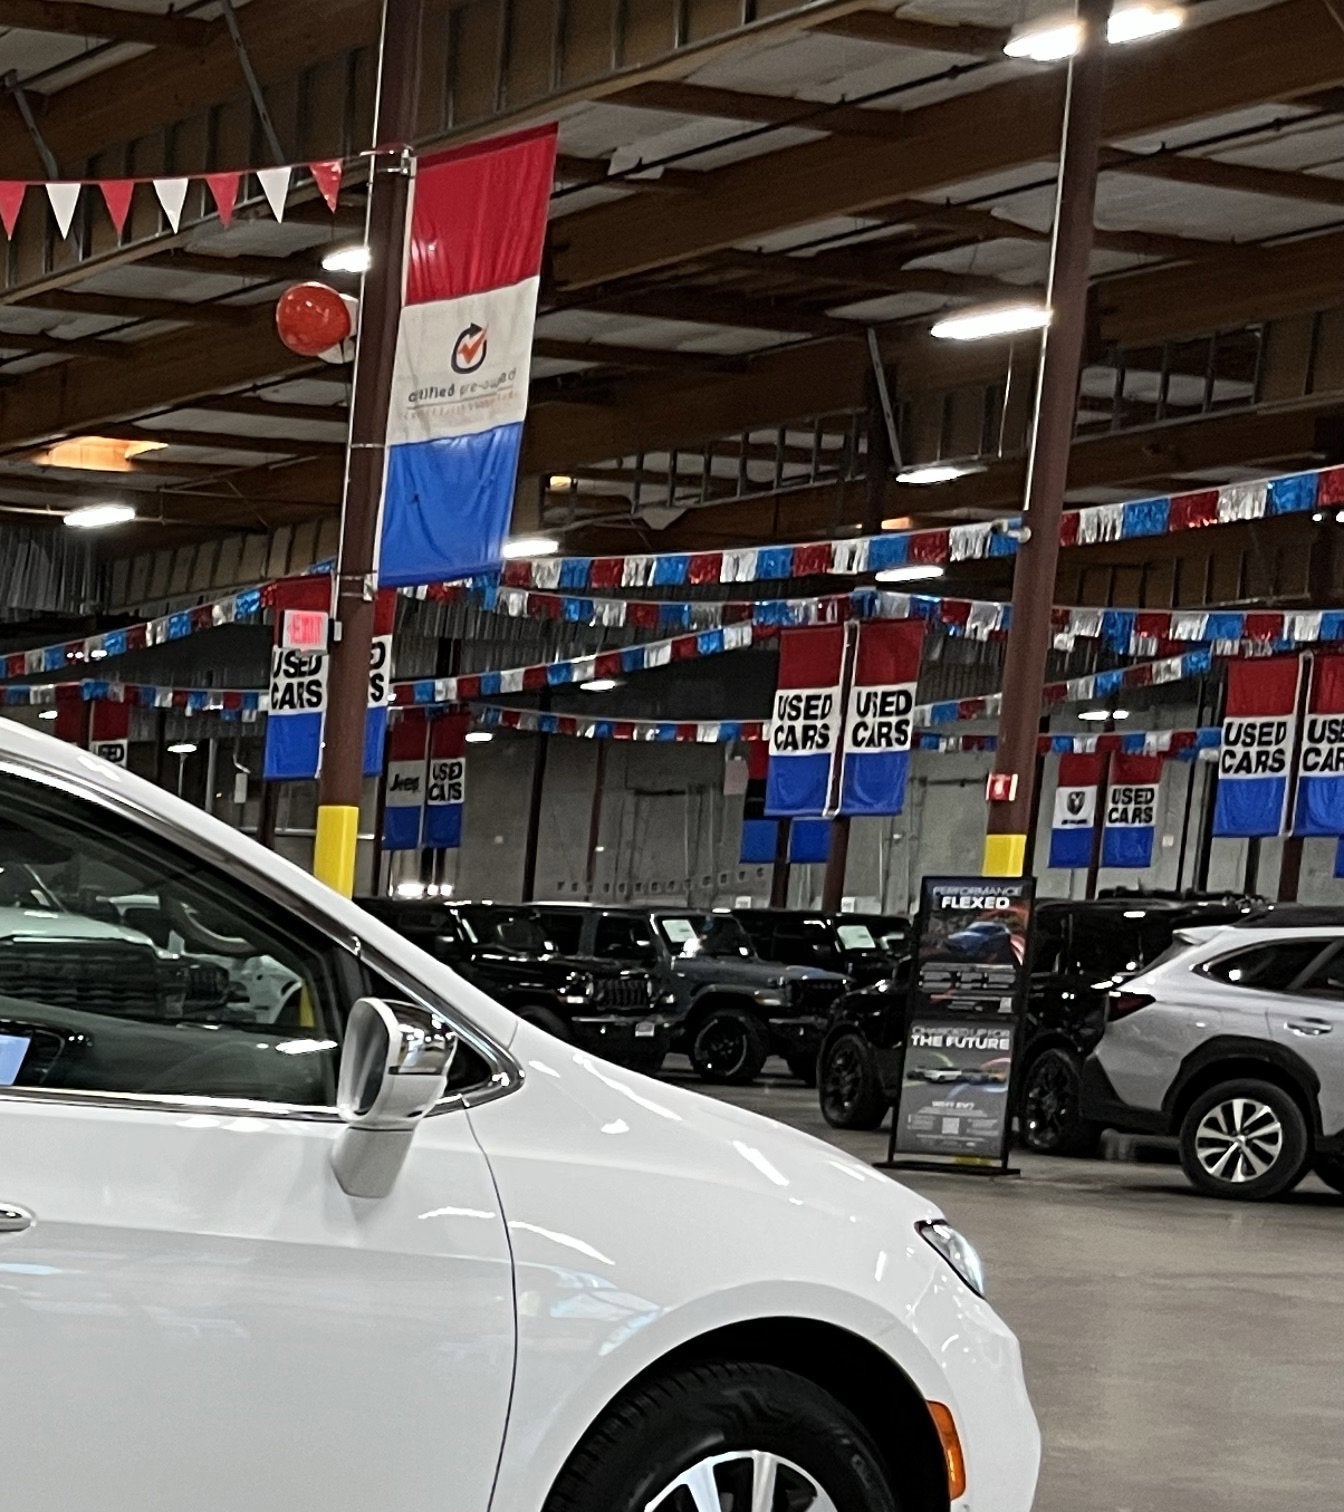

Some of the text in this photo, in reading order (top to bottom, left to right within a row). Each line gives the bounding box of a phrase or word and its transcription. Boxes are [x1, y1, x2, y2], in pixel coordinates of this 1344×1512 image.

[778, 694, 832, 721] USED
[774, 723, 830, 750] CARS
[852, 719, 910, 748] CARS
[1224, 722, 1287, 747] USED
[1307, 719, 1344, 744] US
[1221, 749, 1286, 774] CARS
[1302, 747, 1344, 772] CAR
[1111, 788, 1154, 805] USED
[1108, 807, 1153, 824] CARS
[941, 896, 1010, 909] FLEXED
[911, 1034, 1010, 1050] THE FUTURE
